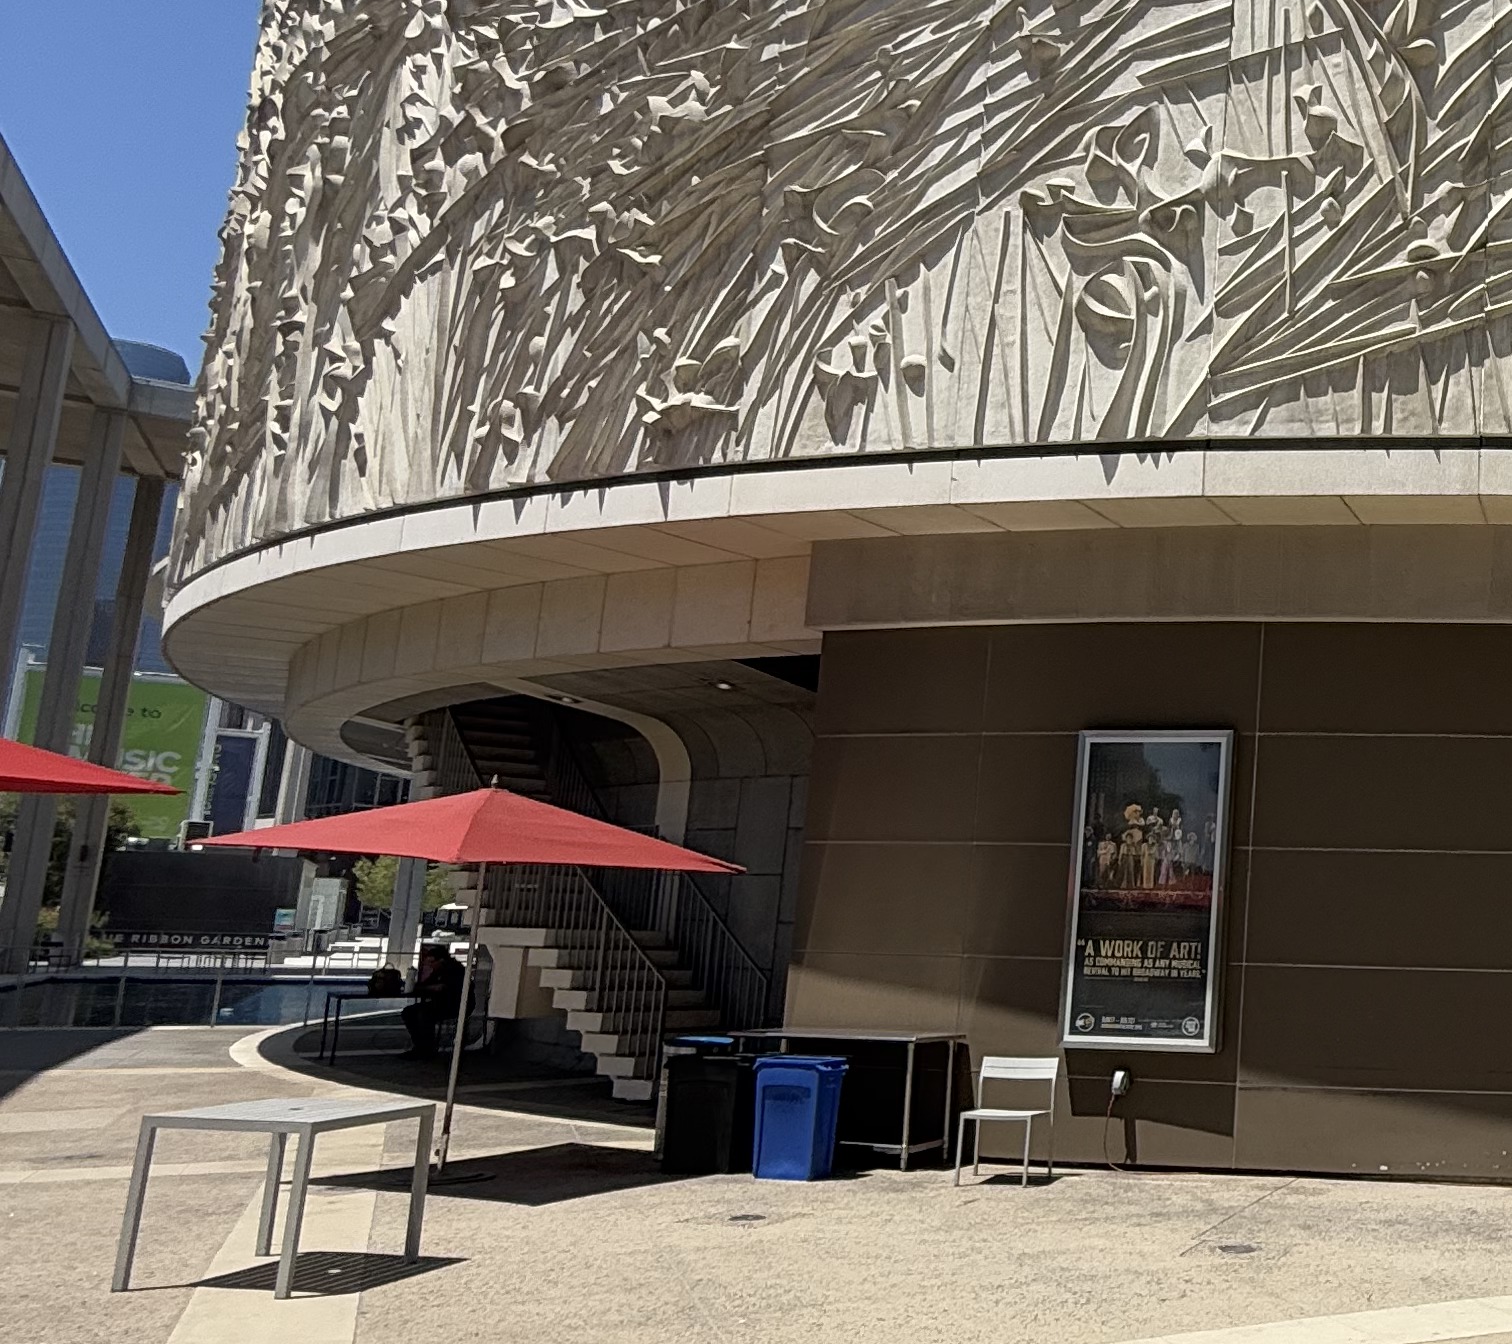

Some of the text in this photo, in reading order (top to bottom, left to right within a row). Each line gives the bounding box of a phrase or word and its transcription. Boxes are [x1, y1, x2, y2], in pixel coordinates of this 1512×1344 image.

[142, 707, 162, 719] to
[130, 934, 194, 945] RIBBON
[1100, 939, 1143, 958] WORK
[1147, 941, 1165, 958] OF
[1170, 941, 1201, 959] ART!
[1084, 957, 1201, 969] AS COMMANDING AS ANY MUSICAL
[1111, 967, 1119, 976] TO
[1132, 968, 1170, 977] BROADWAY
